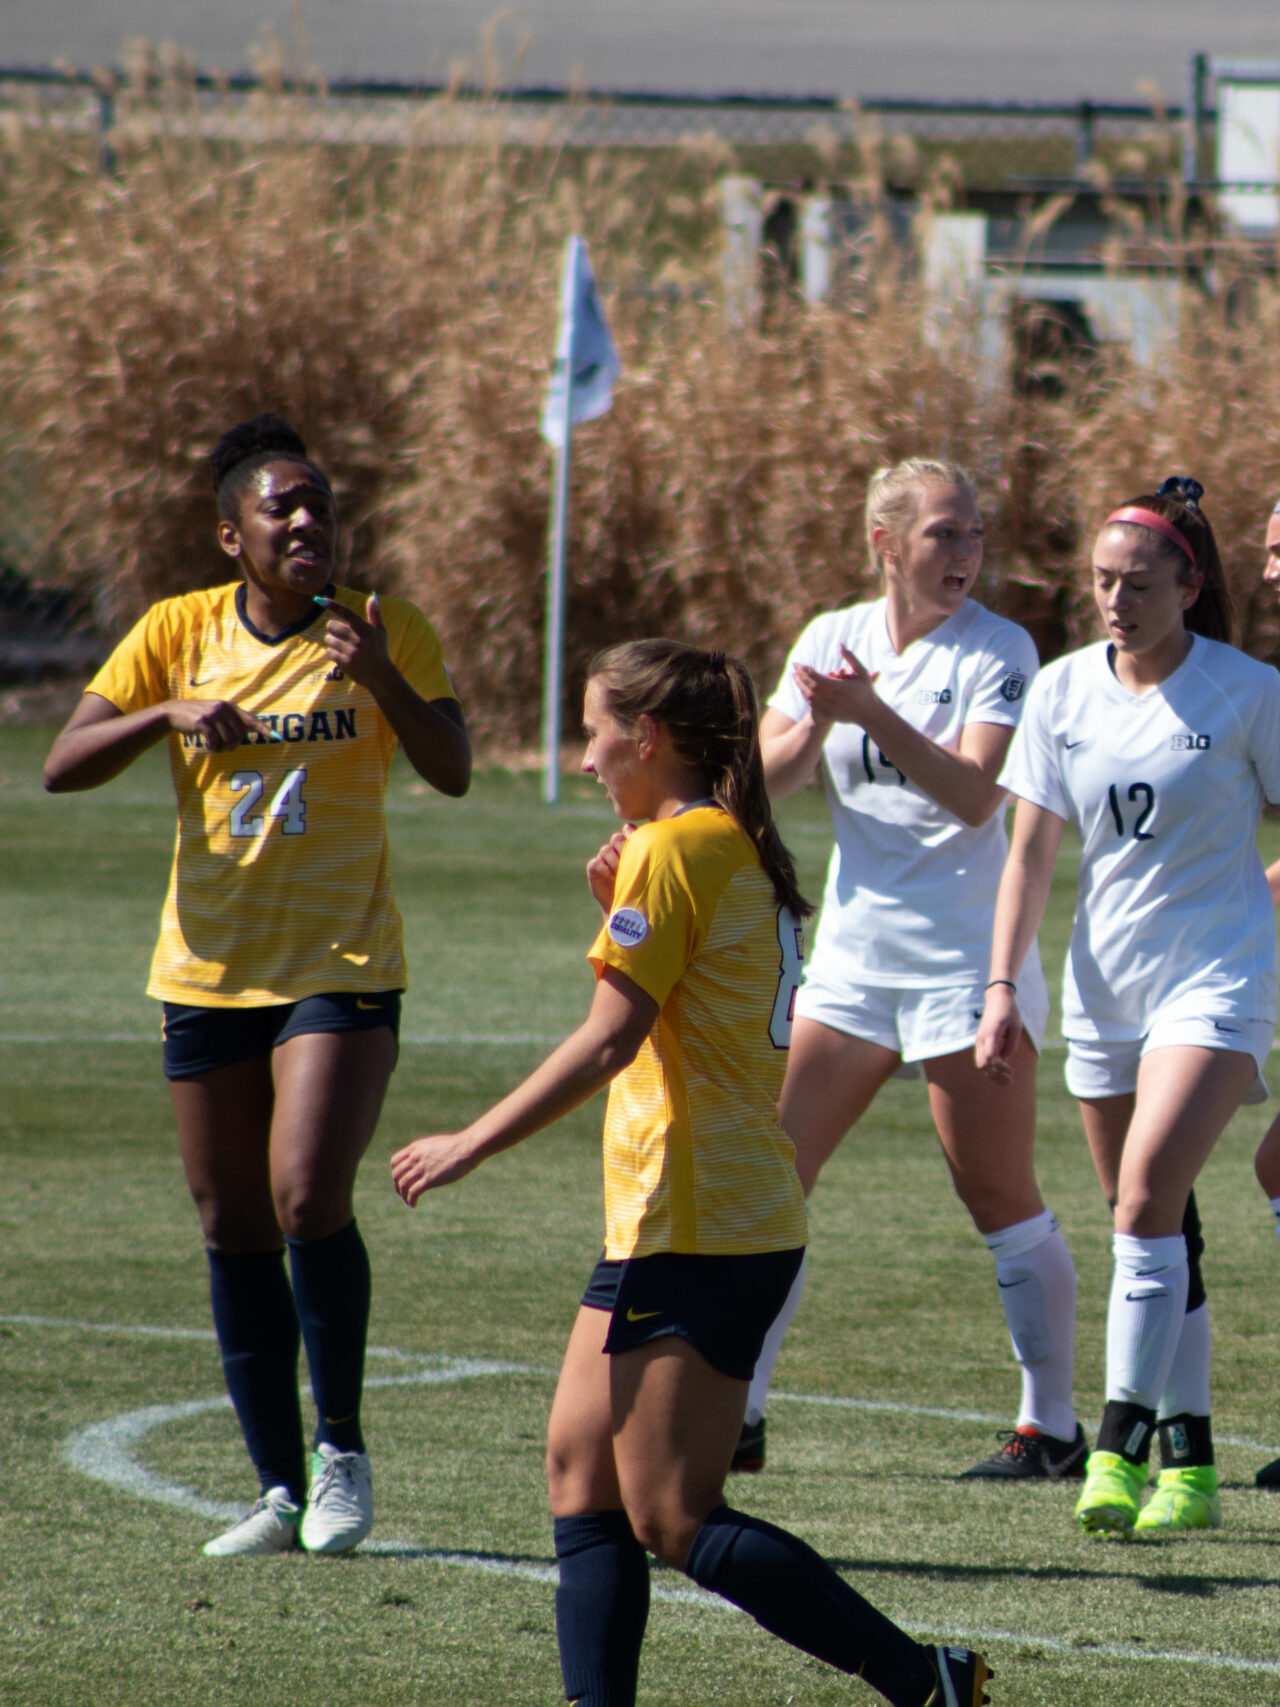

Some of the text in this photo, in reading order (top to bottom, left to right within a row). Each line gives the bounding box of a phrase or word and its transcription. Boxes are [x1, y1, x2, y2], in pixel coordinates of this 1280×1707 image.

[183, 708, 358, 749] MIGAN
[229, 767, 308, 838] 24
[1108, 781, 1156, 841] 12
